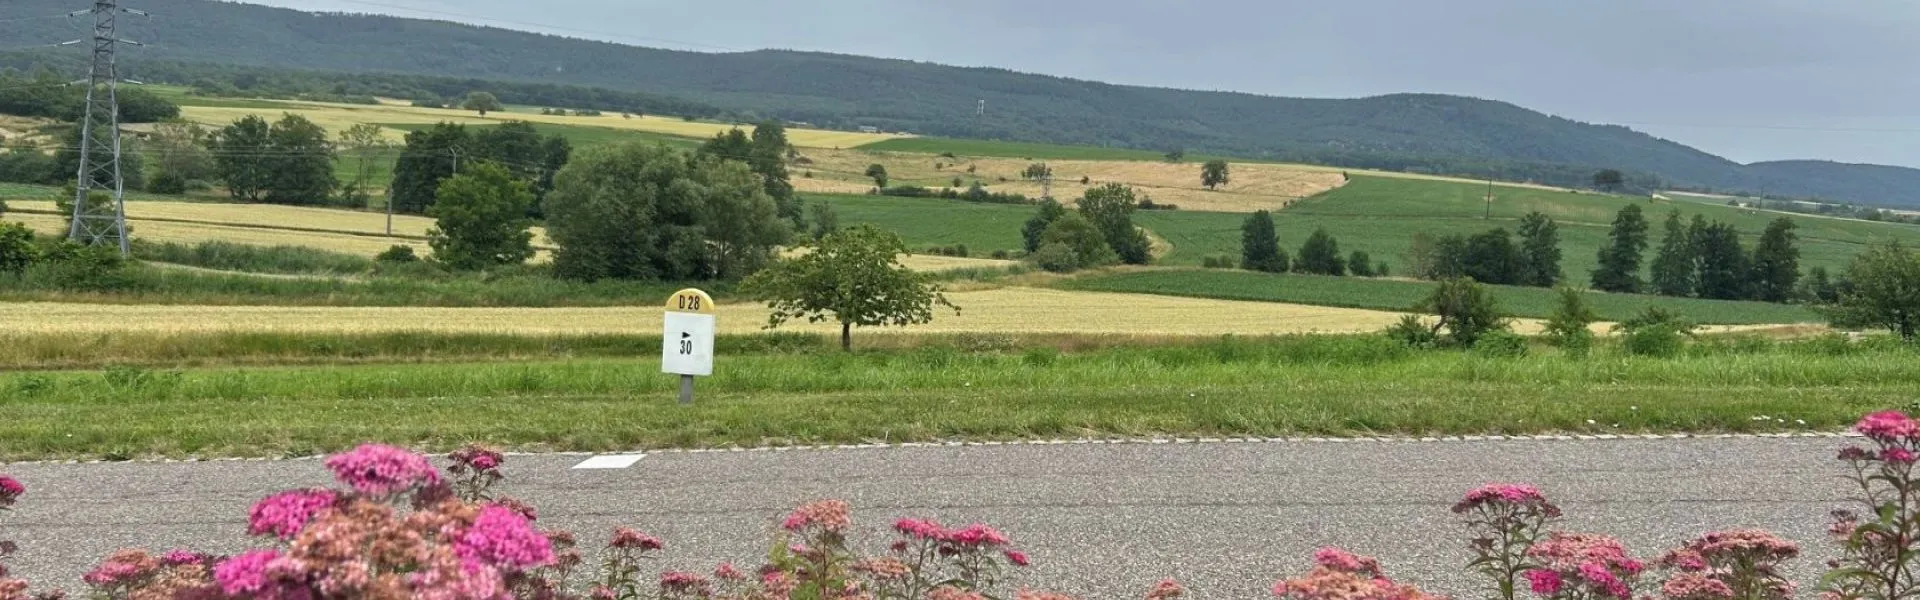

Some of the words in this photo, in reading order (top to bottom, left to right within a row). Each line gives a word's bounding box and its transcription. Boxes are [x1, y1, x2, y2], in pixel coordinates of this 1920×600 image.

[679, 295, 685, 309] D
[688, 295, 700, 310] 28
[680, 340, 692, 355] 30
